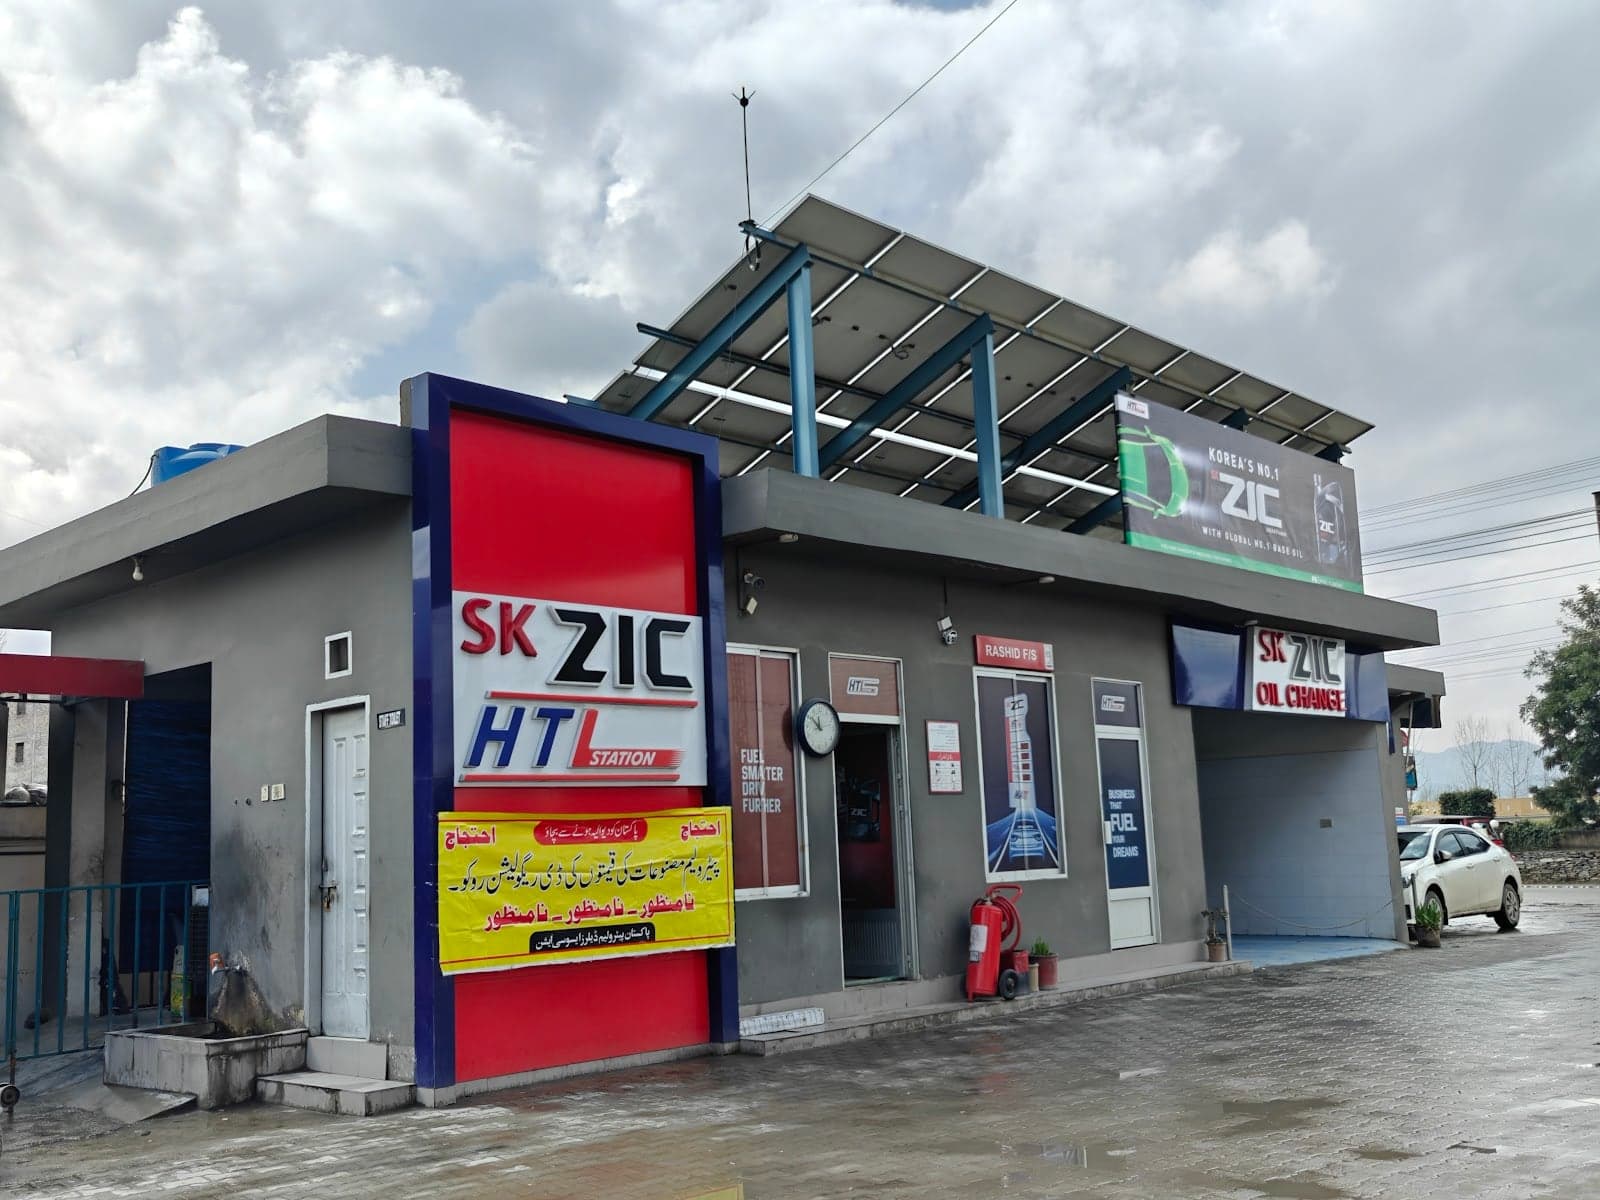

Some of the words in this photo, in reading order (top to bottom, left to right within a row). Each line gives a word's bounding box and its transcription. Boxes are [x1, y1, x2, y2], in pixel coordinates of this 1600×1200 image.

[1208, 447, 1254, 474] KOREA'S
[1256, 462, 1279, 481] NO.1
[1219, 472, 1283, 529] ZIC
[1201, 526, 1221, 539] WITH
[1224, 531, 1252, 547] GLOBAL
[1273, 543, 1290, 556] BASE
[461, 598, 537, 657] SK
[548, 606, 693, 690] ZIC
[985, 644, 1020, 660] RASHID
[1022, 648, 1037, 661] F/S
[1258, 629, 1287, 663] SK
[1287, 634, 1342, 684] ZIC
[1256, 681, 1284, 706] OIL
[1285, 683, 1347, 713] CHANGE
[463, 705, 600, 769] HTL
[589, 751, 656, 766] STATION
[741, 749, 765, 763] FUEL
[680, 820, 721, 842] احتجاج
[1110, 813, 1137, 832] FUEL
[445, 826, 496, 850] احتجاج
[1112, 846, 1139, 858] DREAMS
[616, 851, 633, 886] کی
[484, 902, 548, 932] نامنظور
[566, 897, 624, 925] نامنظور
[640, 892, 695, 919] نامنظور
[624, 926, 651, 941] پاکستان
